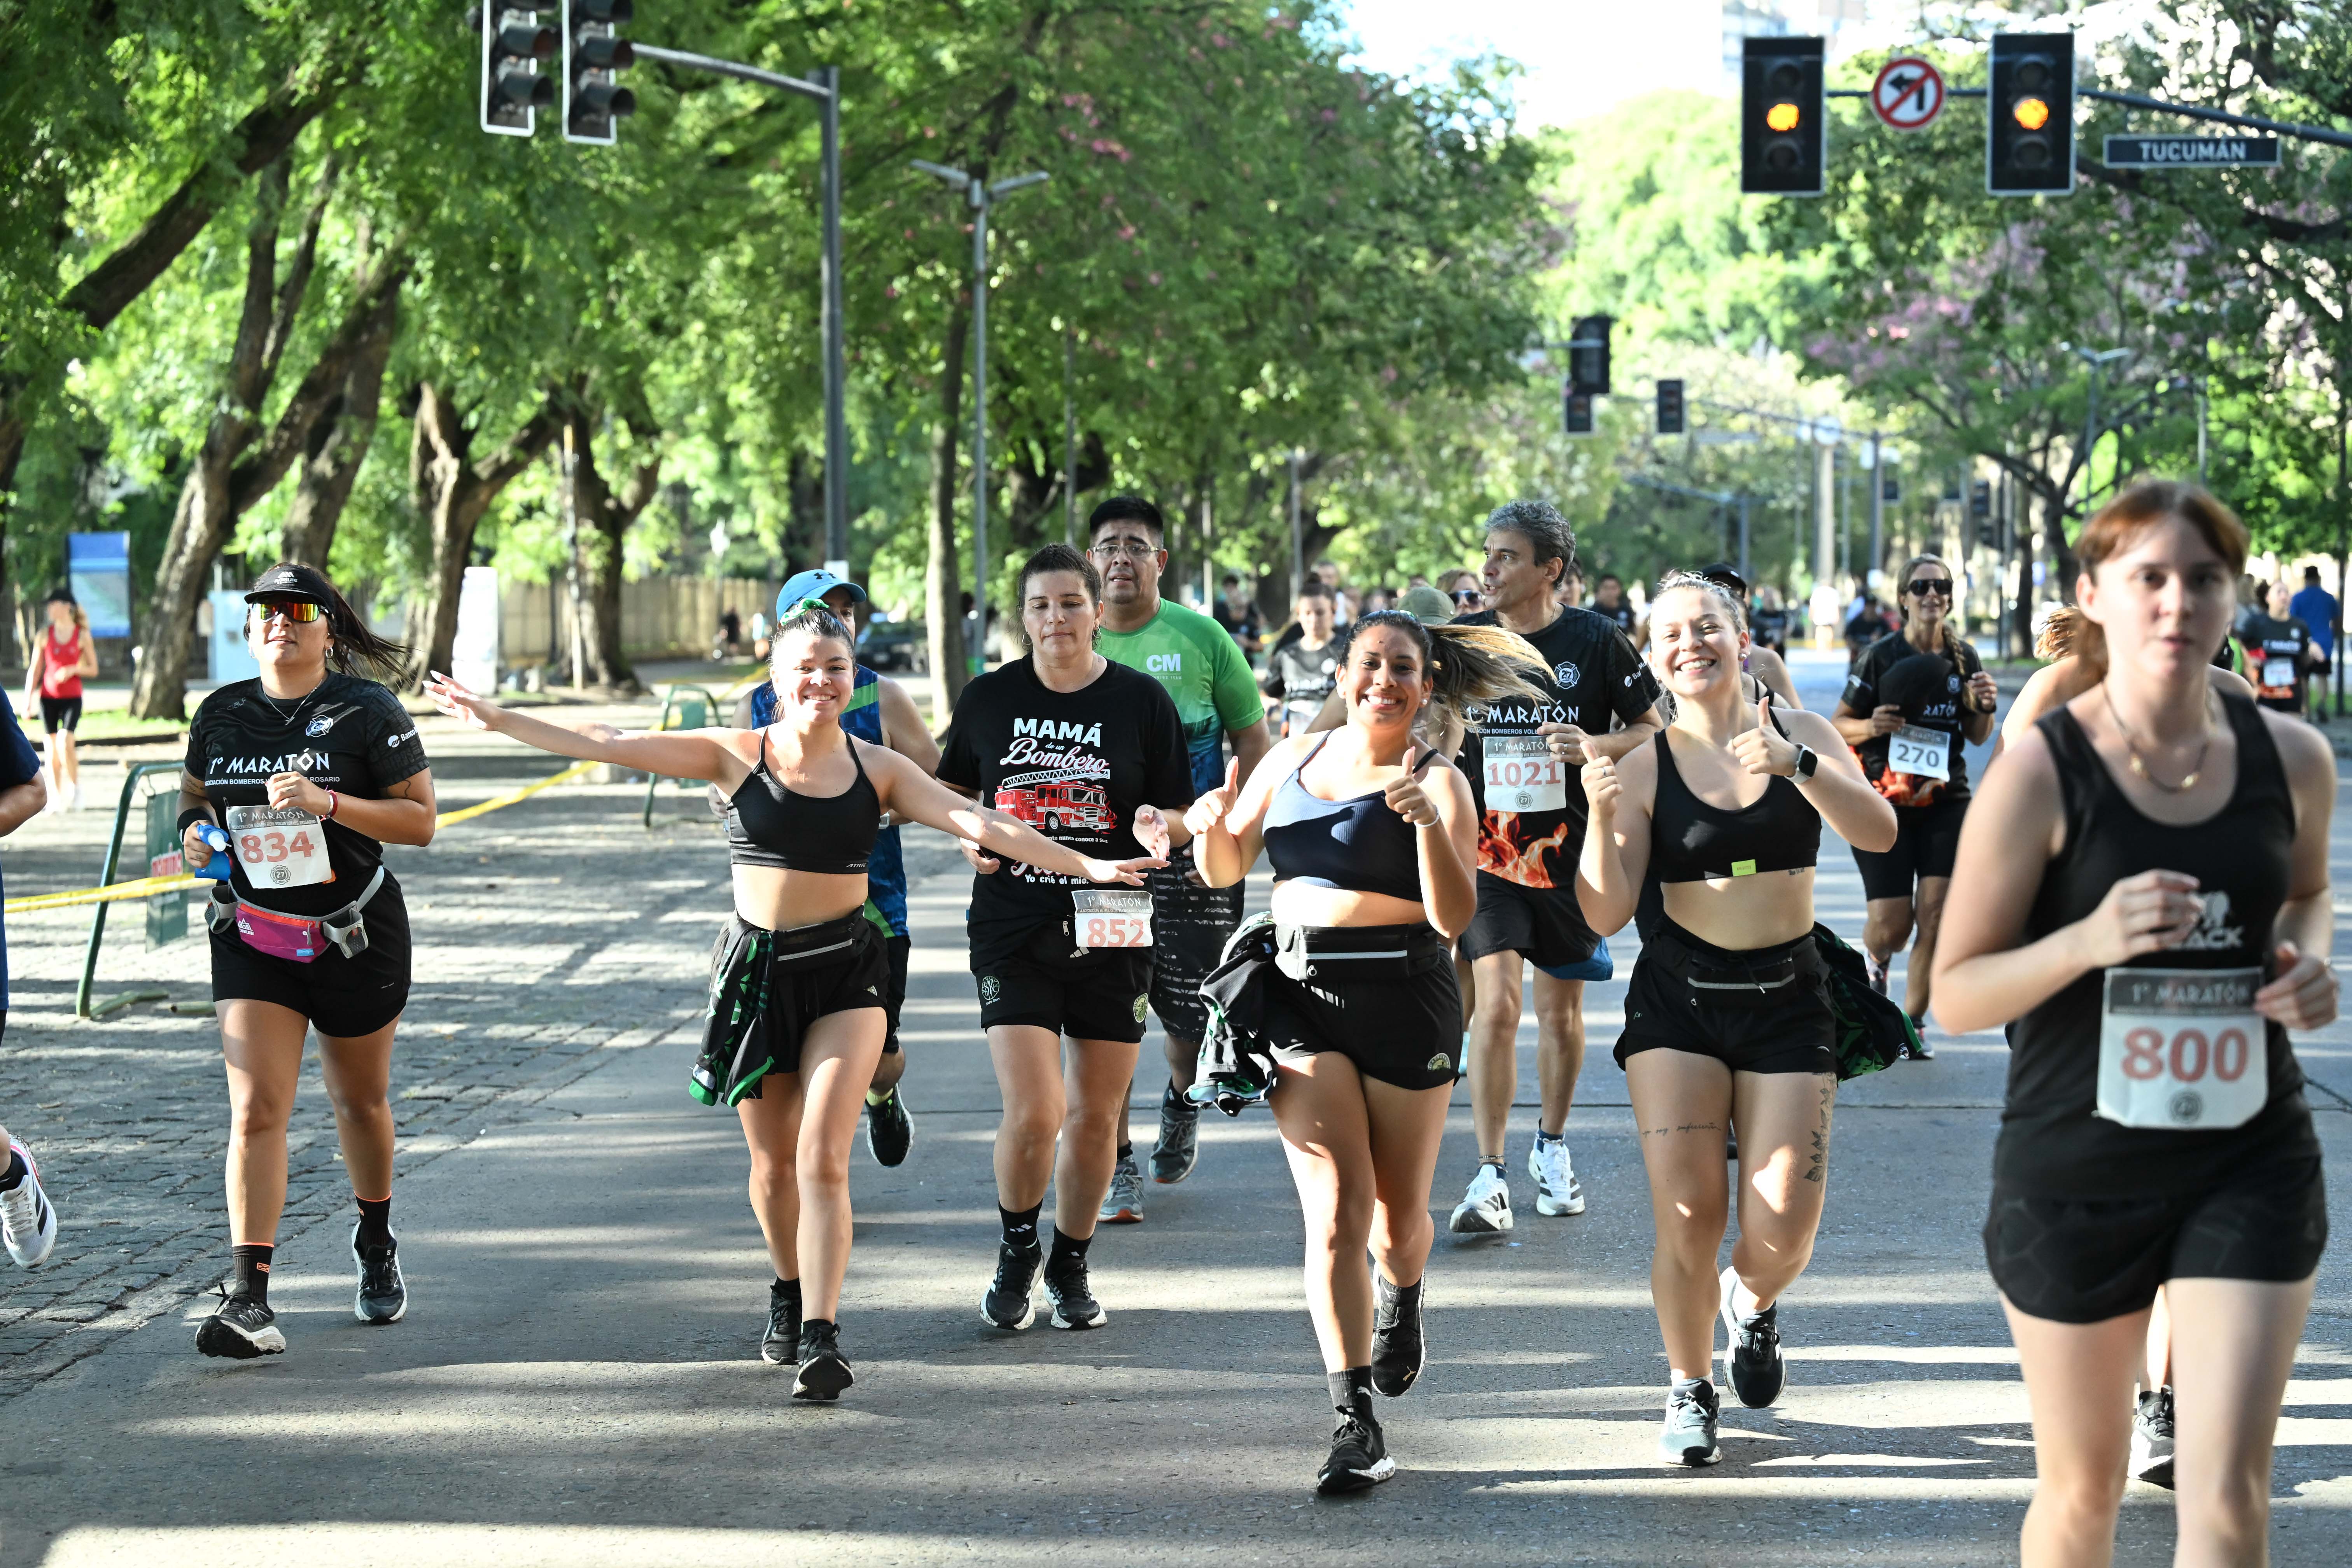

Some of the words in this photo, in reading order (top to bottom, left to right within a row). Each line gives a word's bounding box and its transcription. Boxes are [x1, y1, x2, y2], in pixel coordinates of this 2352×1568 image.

[2139, 136, 2246, 161] TUCUMÁN
[1146, 653, 1181, 672] CM
[1487, 700, 1579, 723] MARATÓN
[401, 729, 416, 742] Banco
[1013, 718, 1103, 747] MAMÁ
[226, 747, 330, 774] MARATÓN
[999, 737, 1110, 773] Bombero
[1897, 743, 1939, 767] 270
[1488, 761, 1561, 786] 1021
[252, 809, 304, 821] MARATÓN
[241, 831, 314, 863] 834
[1025, 874, 1036, 883] Yo
[1040, 875, 1055, 884] crié
[1059, 876, 1067, 884] el
[1071, 876, 1089, 885] mío.
[1099, 894, 1141, 907] MARATÓN
[1087, 918, 1144, 947] 852
[2155, 978, 2250, 1004] MARATÓN
[2121, 1026, 2249, 1084] 800
